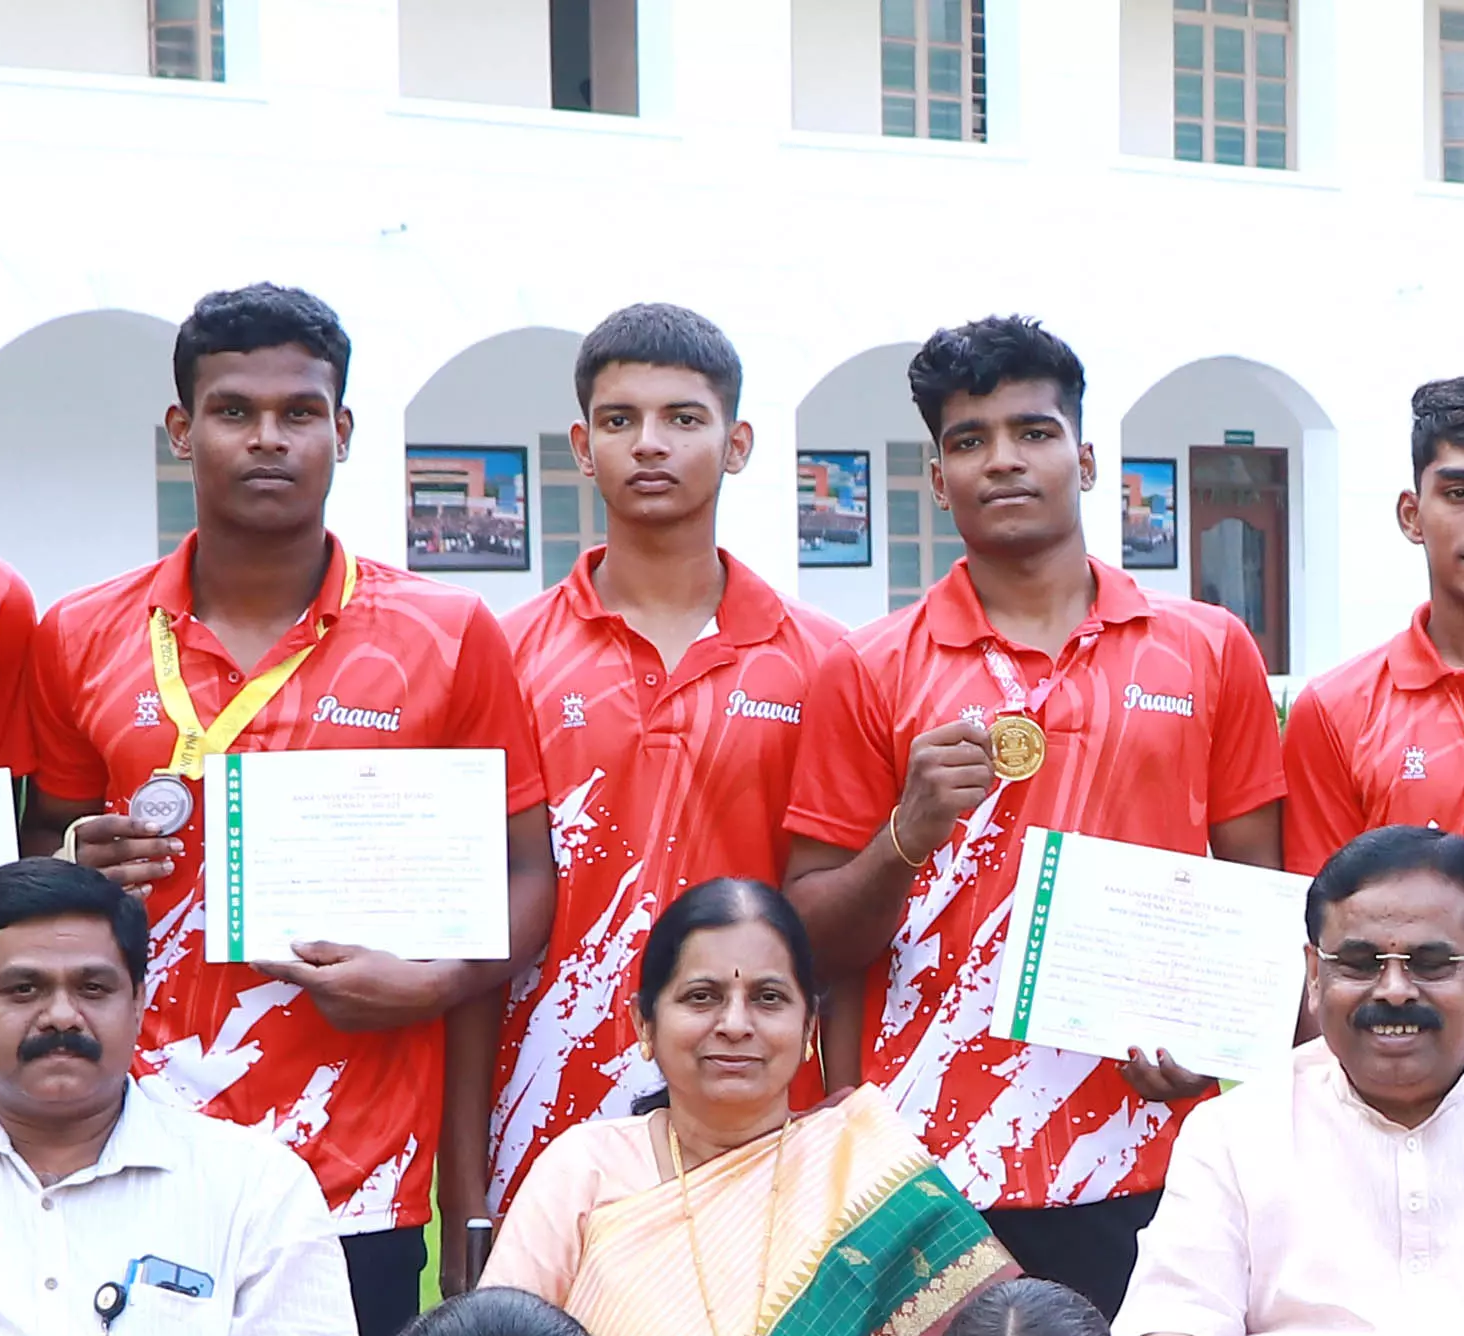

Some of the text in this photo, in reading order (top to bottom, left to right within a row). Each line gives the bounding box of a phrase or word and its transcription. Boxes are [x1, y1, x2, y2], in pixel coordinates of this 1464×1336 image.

[312, 695, 402, 732] Paavai
[724, 689, 802, 724] Paavai
[1124, 683, 1195, 718] Paavai
